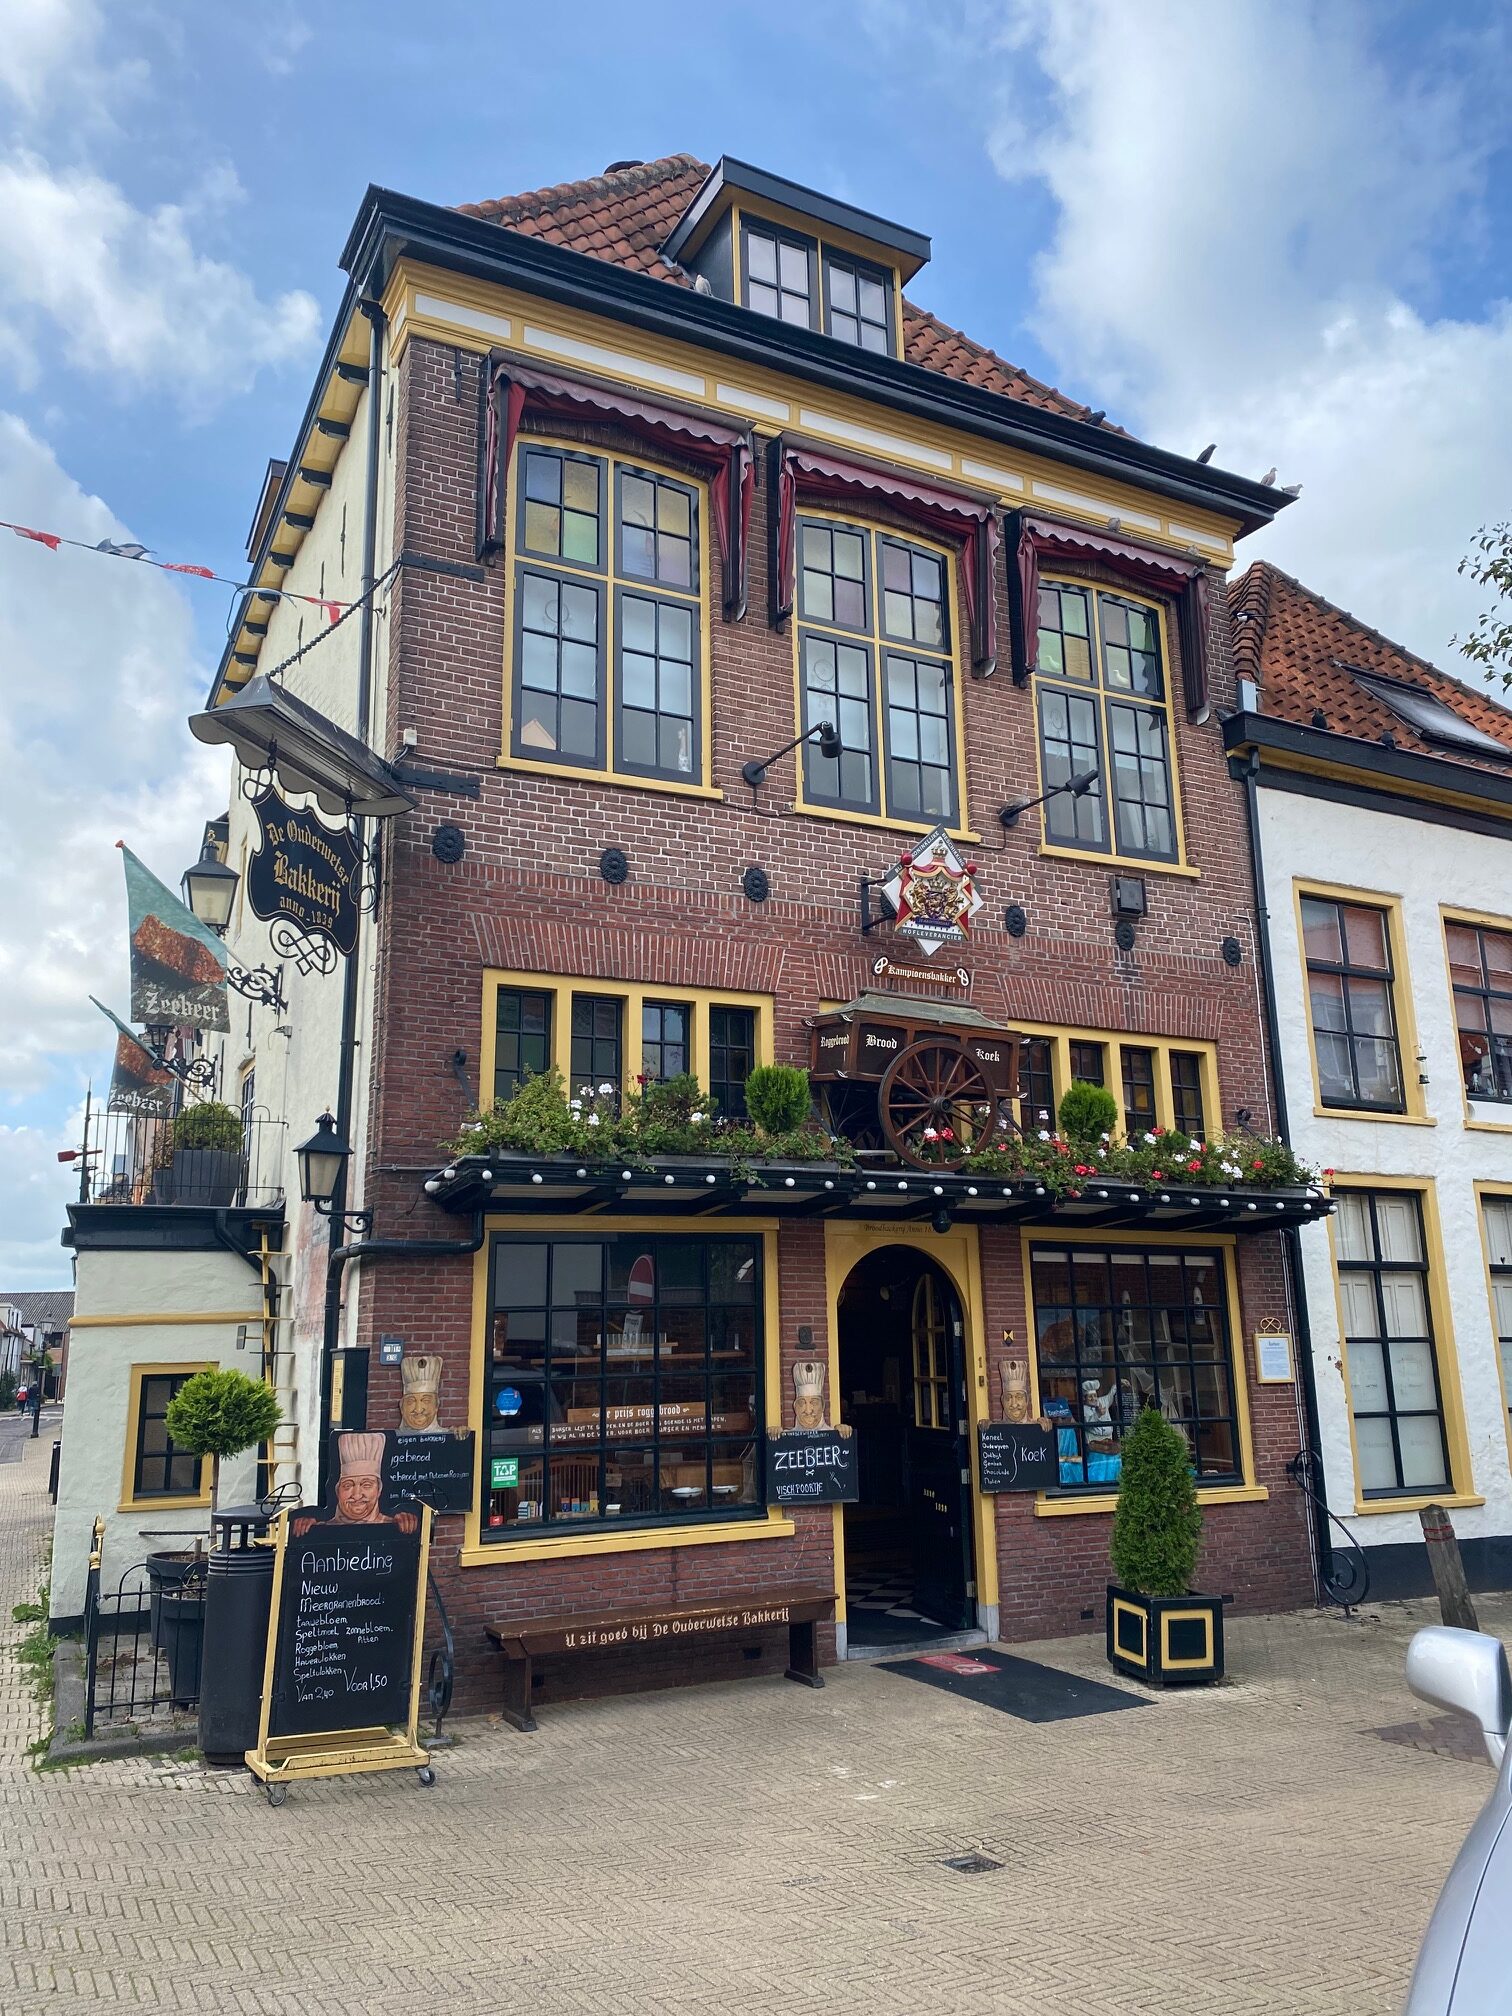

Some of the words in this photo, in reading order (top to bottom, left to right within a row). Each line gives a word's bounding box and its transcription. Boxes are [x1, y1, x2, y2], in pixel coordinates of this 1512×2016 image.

[266, 822, 285, 846] De
[287, 820, 350, 886] Ouderwetse
[273, 850, 340, 917] Bakkerij
[280, 896, 305, 917] anno
[902, 928, 962, 941] HOFLEVERANCIER
[888, 964, 957, 983] Kampioensbakker
[144, 991, 220, 1021] Zeebeer
[866, 1034, 898, 1049] Brood
[975, 1048, 1000, 1062] Koek
[637, 1404, 681, 1418] roggbrood
[774, 1445, 848, 1471] ZEEBEER
[301, 1545, 393, 1575] Aanbieding
[301, 1580, 339, 1595] Nieuw
[579, 1630, 596, 1645] zit
[599, 1627, 628, 1645] goed
[632, 1625, 648, 1640] bij
[652, 1623, 669, 1638] De
[672, 1612, 739, 1633] Ouderwetse
[742, 1607, 790, 1626] Bakkerij
[296, 1685, 314, 1703] Van
